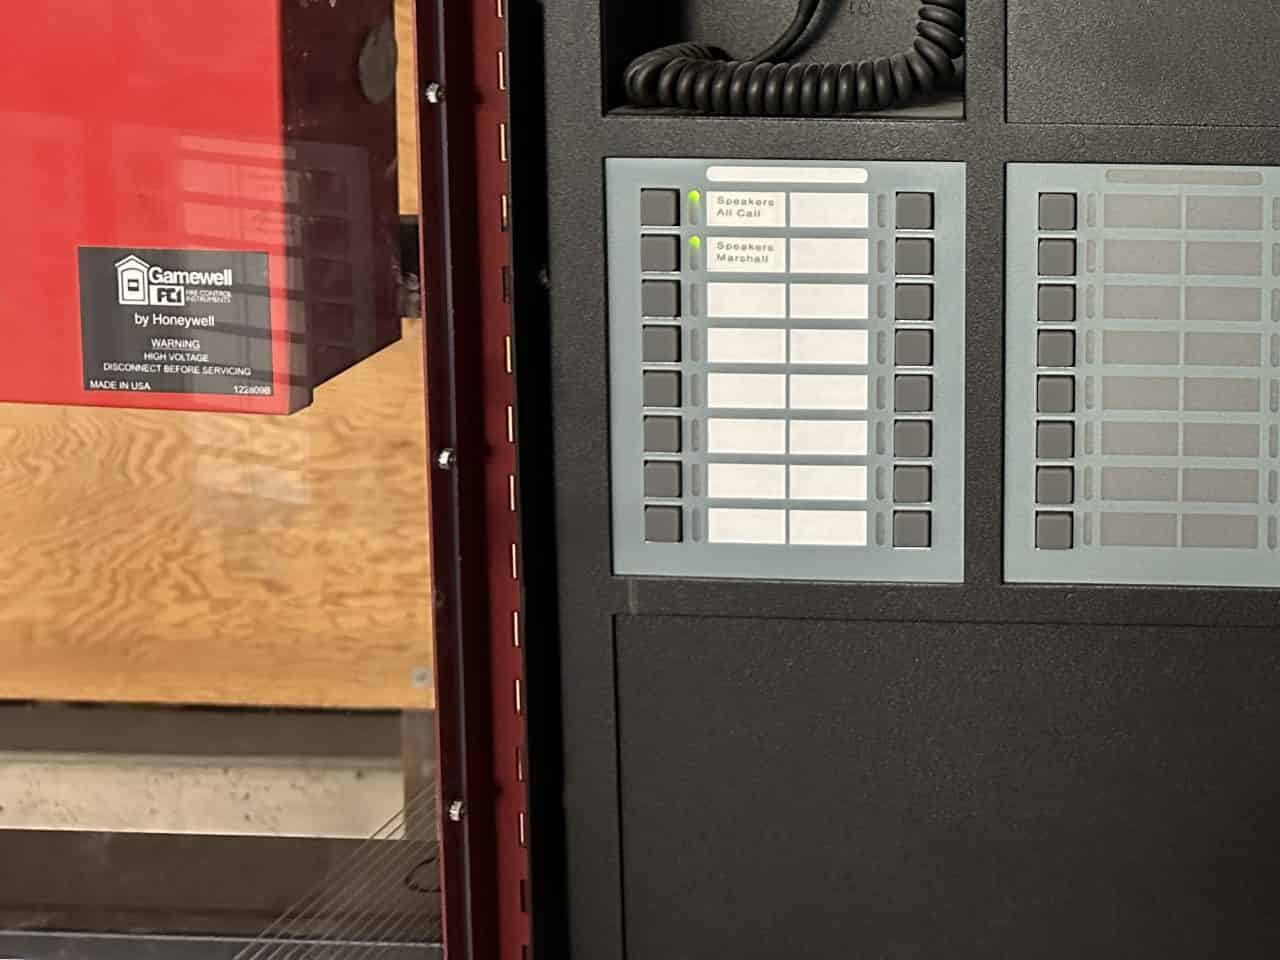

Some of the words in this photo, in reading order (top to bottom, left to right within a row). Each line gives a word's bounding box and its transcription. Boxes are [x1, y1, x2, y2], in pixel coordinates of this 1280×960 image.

[717, 195, 774, 207] Speakers
[716, 208, 732, 216] All
[736, 208, 761, 217] Call
[716, 241, 774, 251] Speakers
[716, 253, 769, 263] Marshall
[149, 266, 232, 286] Gamewell
[156, 287, 182, 303] FCI
[134, 312, 149, 327] by
[152, 313, 215, 329] Honeywell
[151, 338, 201, 349] WARNING
[143, 352, 167, 361] HIGH
[169, 353, 209, 362] VOLTAGE
[103, 362, 162, 373] DISCONNECT
[164, 364, 200, 375] BEFORE
[202, 366, 252, 376] SERVICING
[90, 380, 116, 390] MADE
[119, 381, 129, 390] IN
[131, 381, 152, 391] USA
